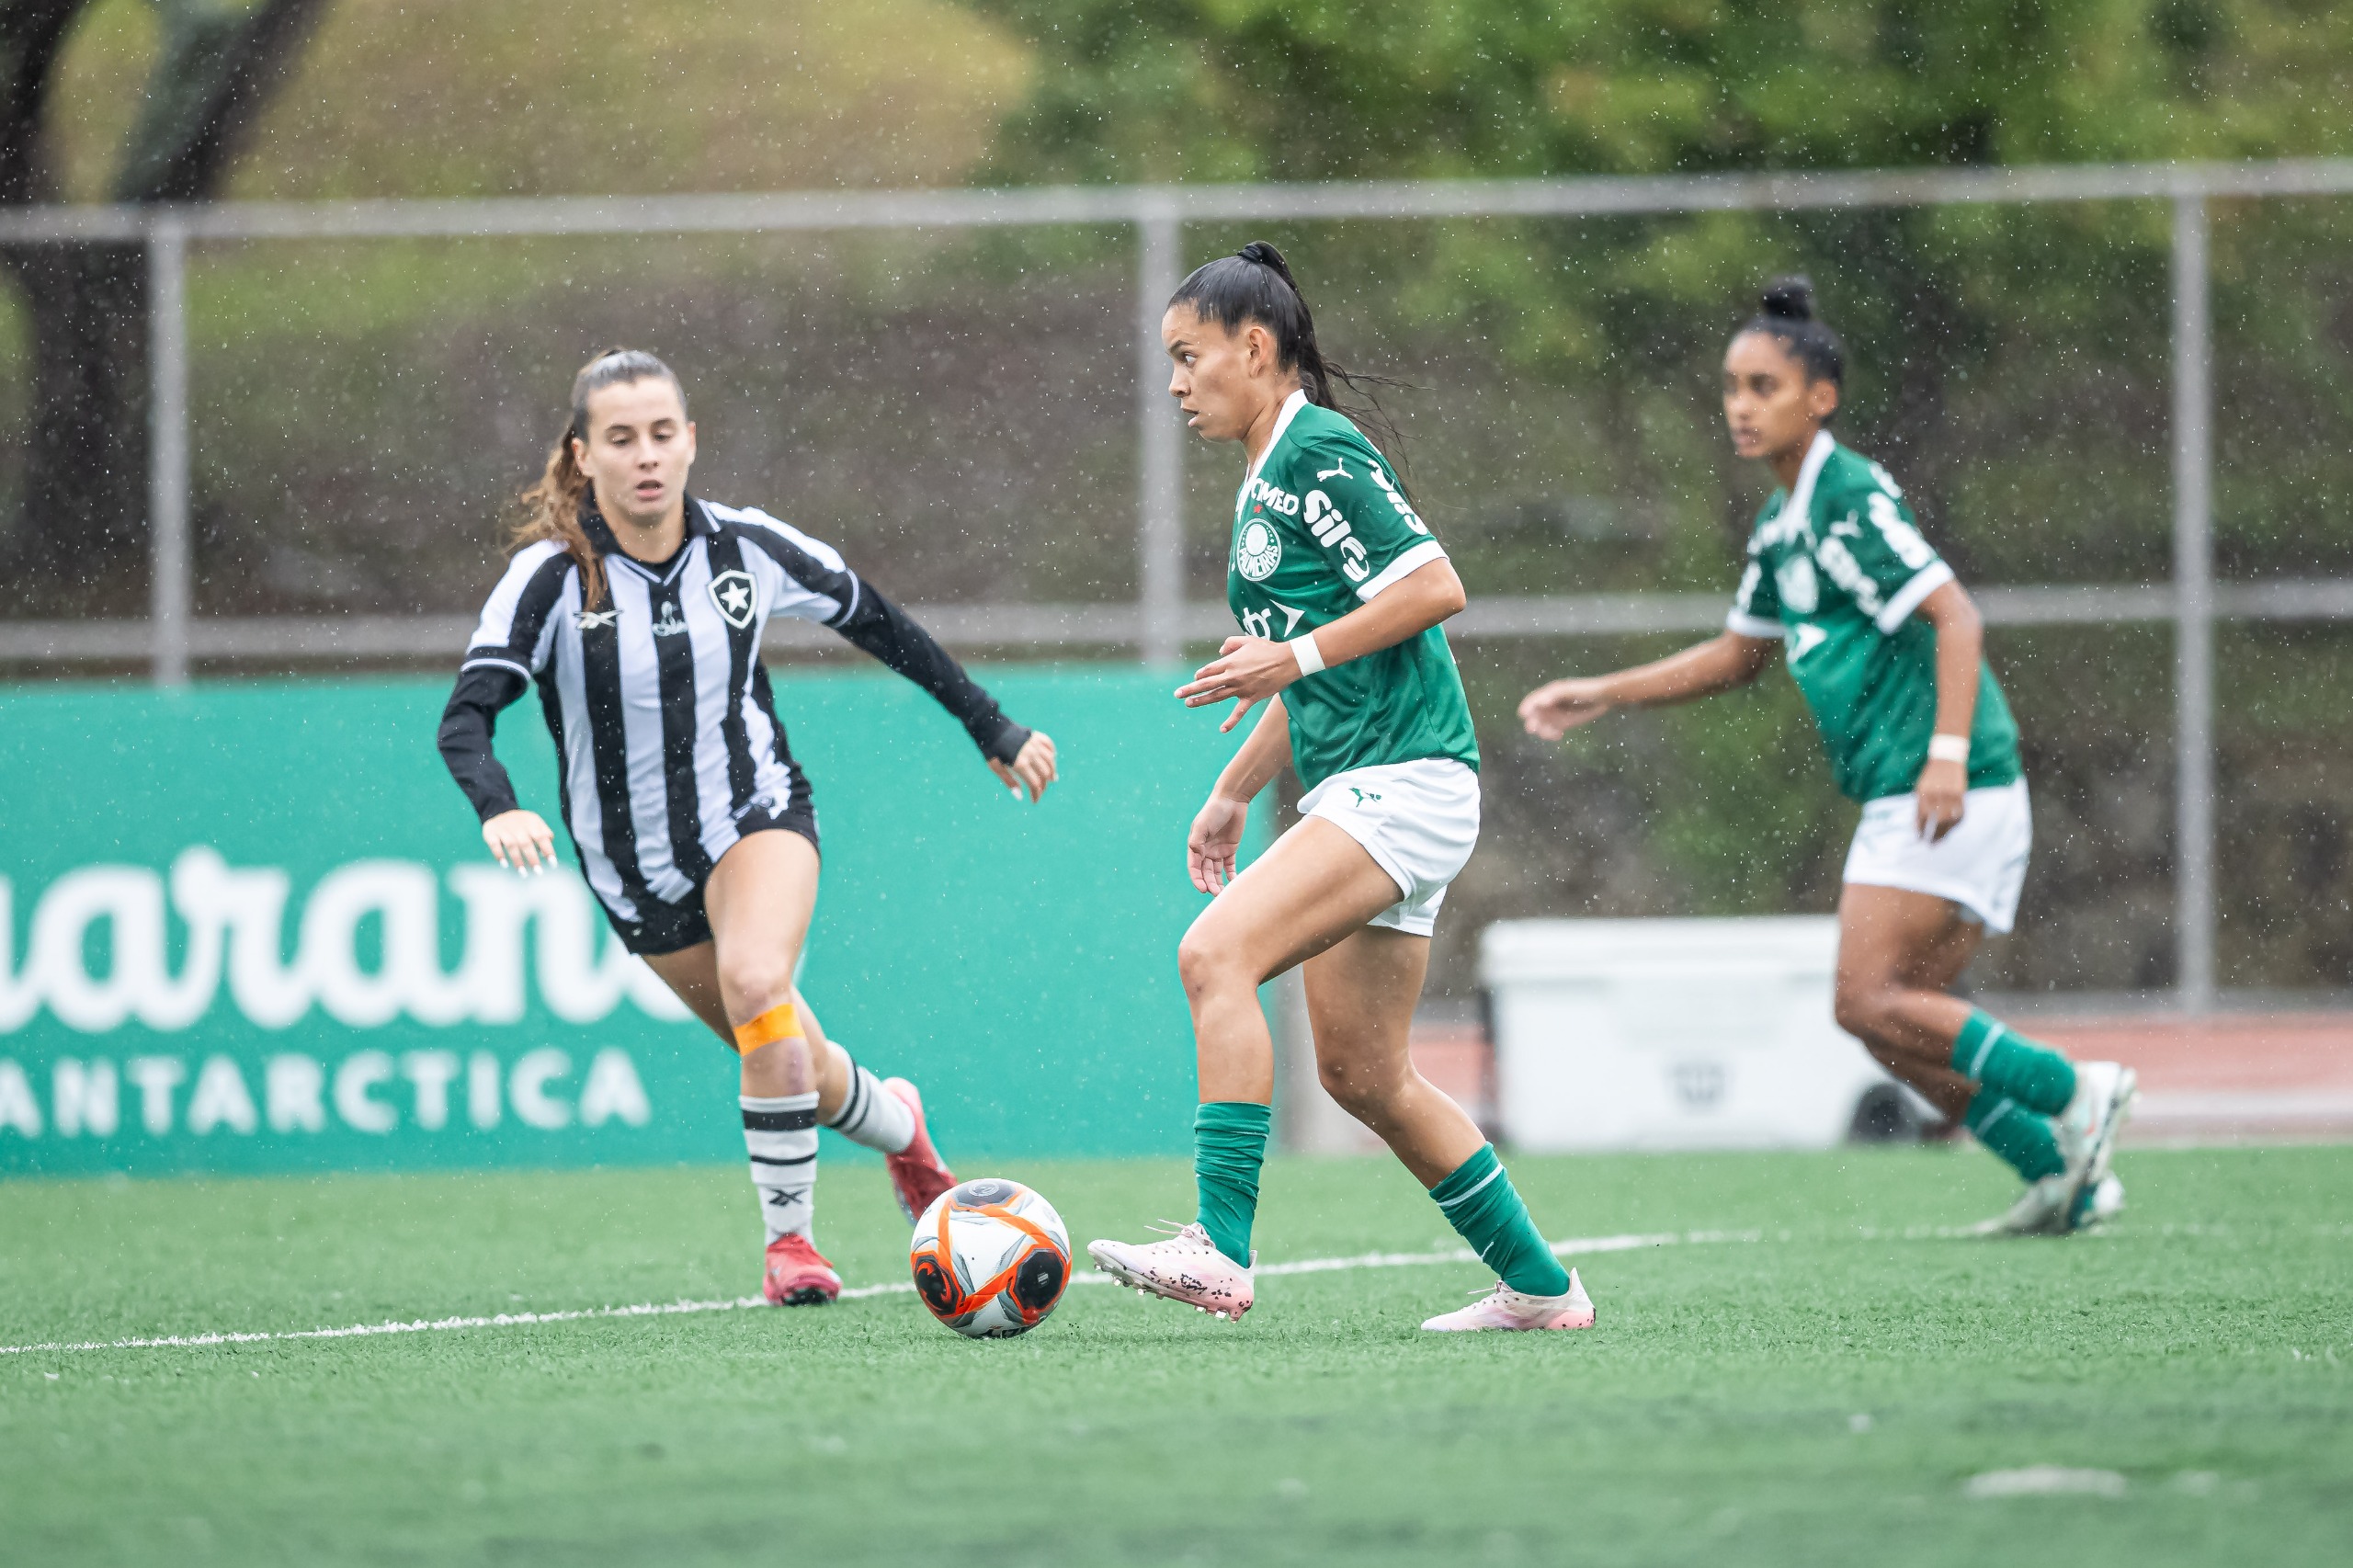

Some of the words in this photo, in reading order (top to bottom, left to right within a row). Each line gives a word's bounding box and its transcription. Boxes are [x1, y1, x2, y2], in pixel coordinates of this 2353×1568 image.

[1239, 544, 1279, 577] PALMEIRAS
[0, 846, 704, 1033] aran
[0, 1048, 648, 1137] ANTARCTICA
